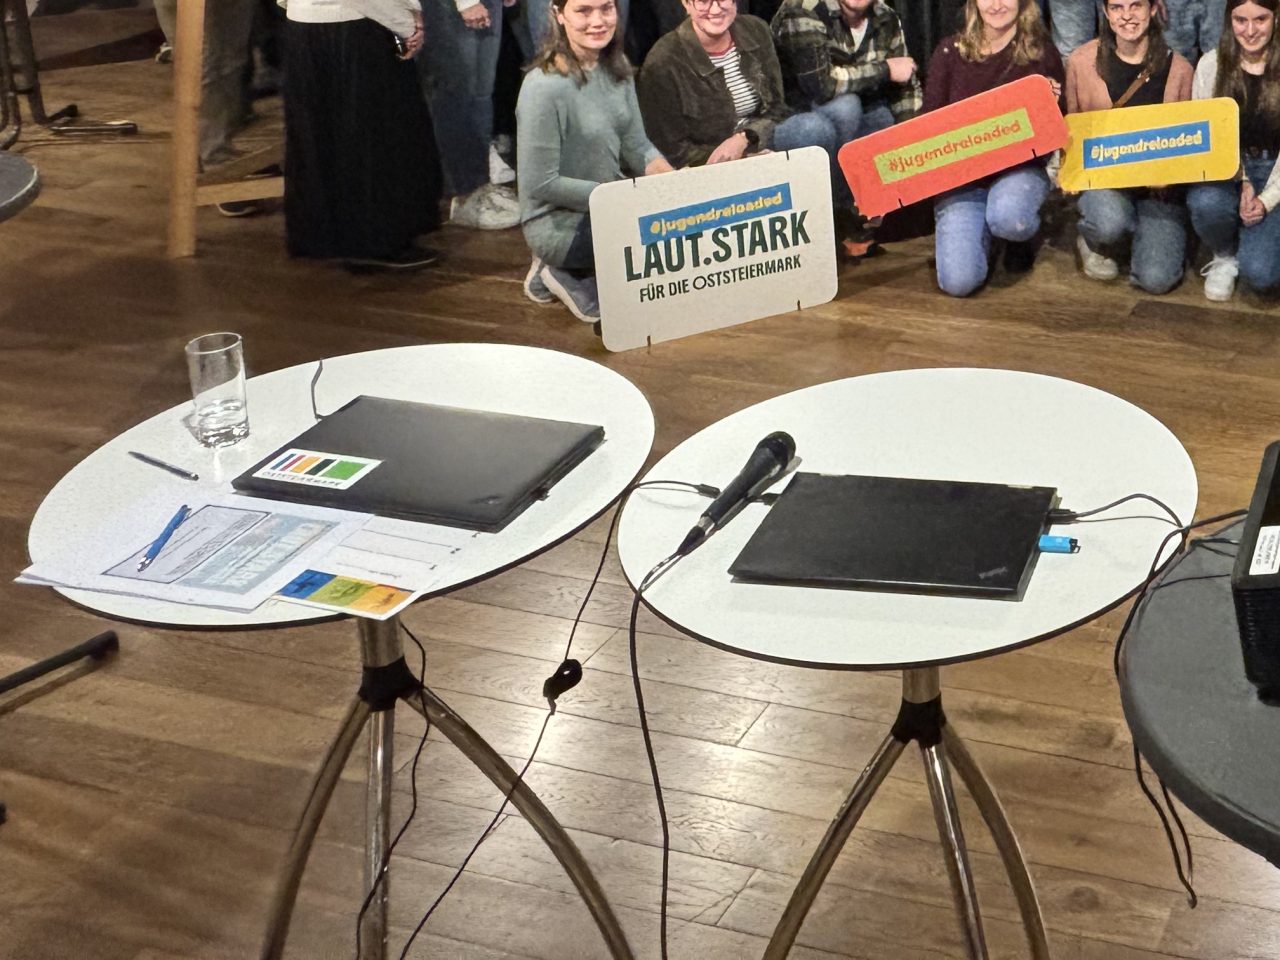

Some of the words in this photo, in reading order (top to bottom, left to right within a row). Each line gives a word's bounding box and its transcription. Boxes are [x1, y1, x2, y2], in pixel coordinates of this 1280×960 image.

[623, 209, 812, 282] LAUT.STARK
[639, 282, 666, 303] FÜR
[668, 278, 690, 297] DIE
[692, 253, 802, 291] OSTSTEIERMARK
